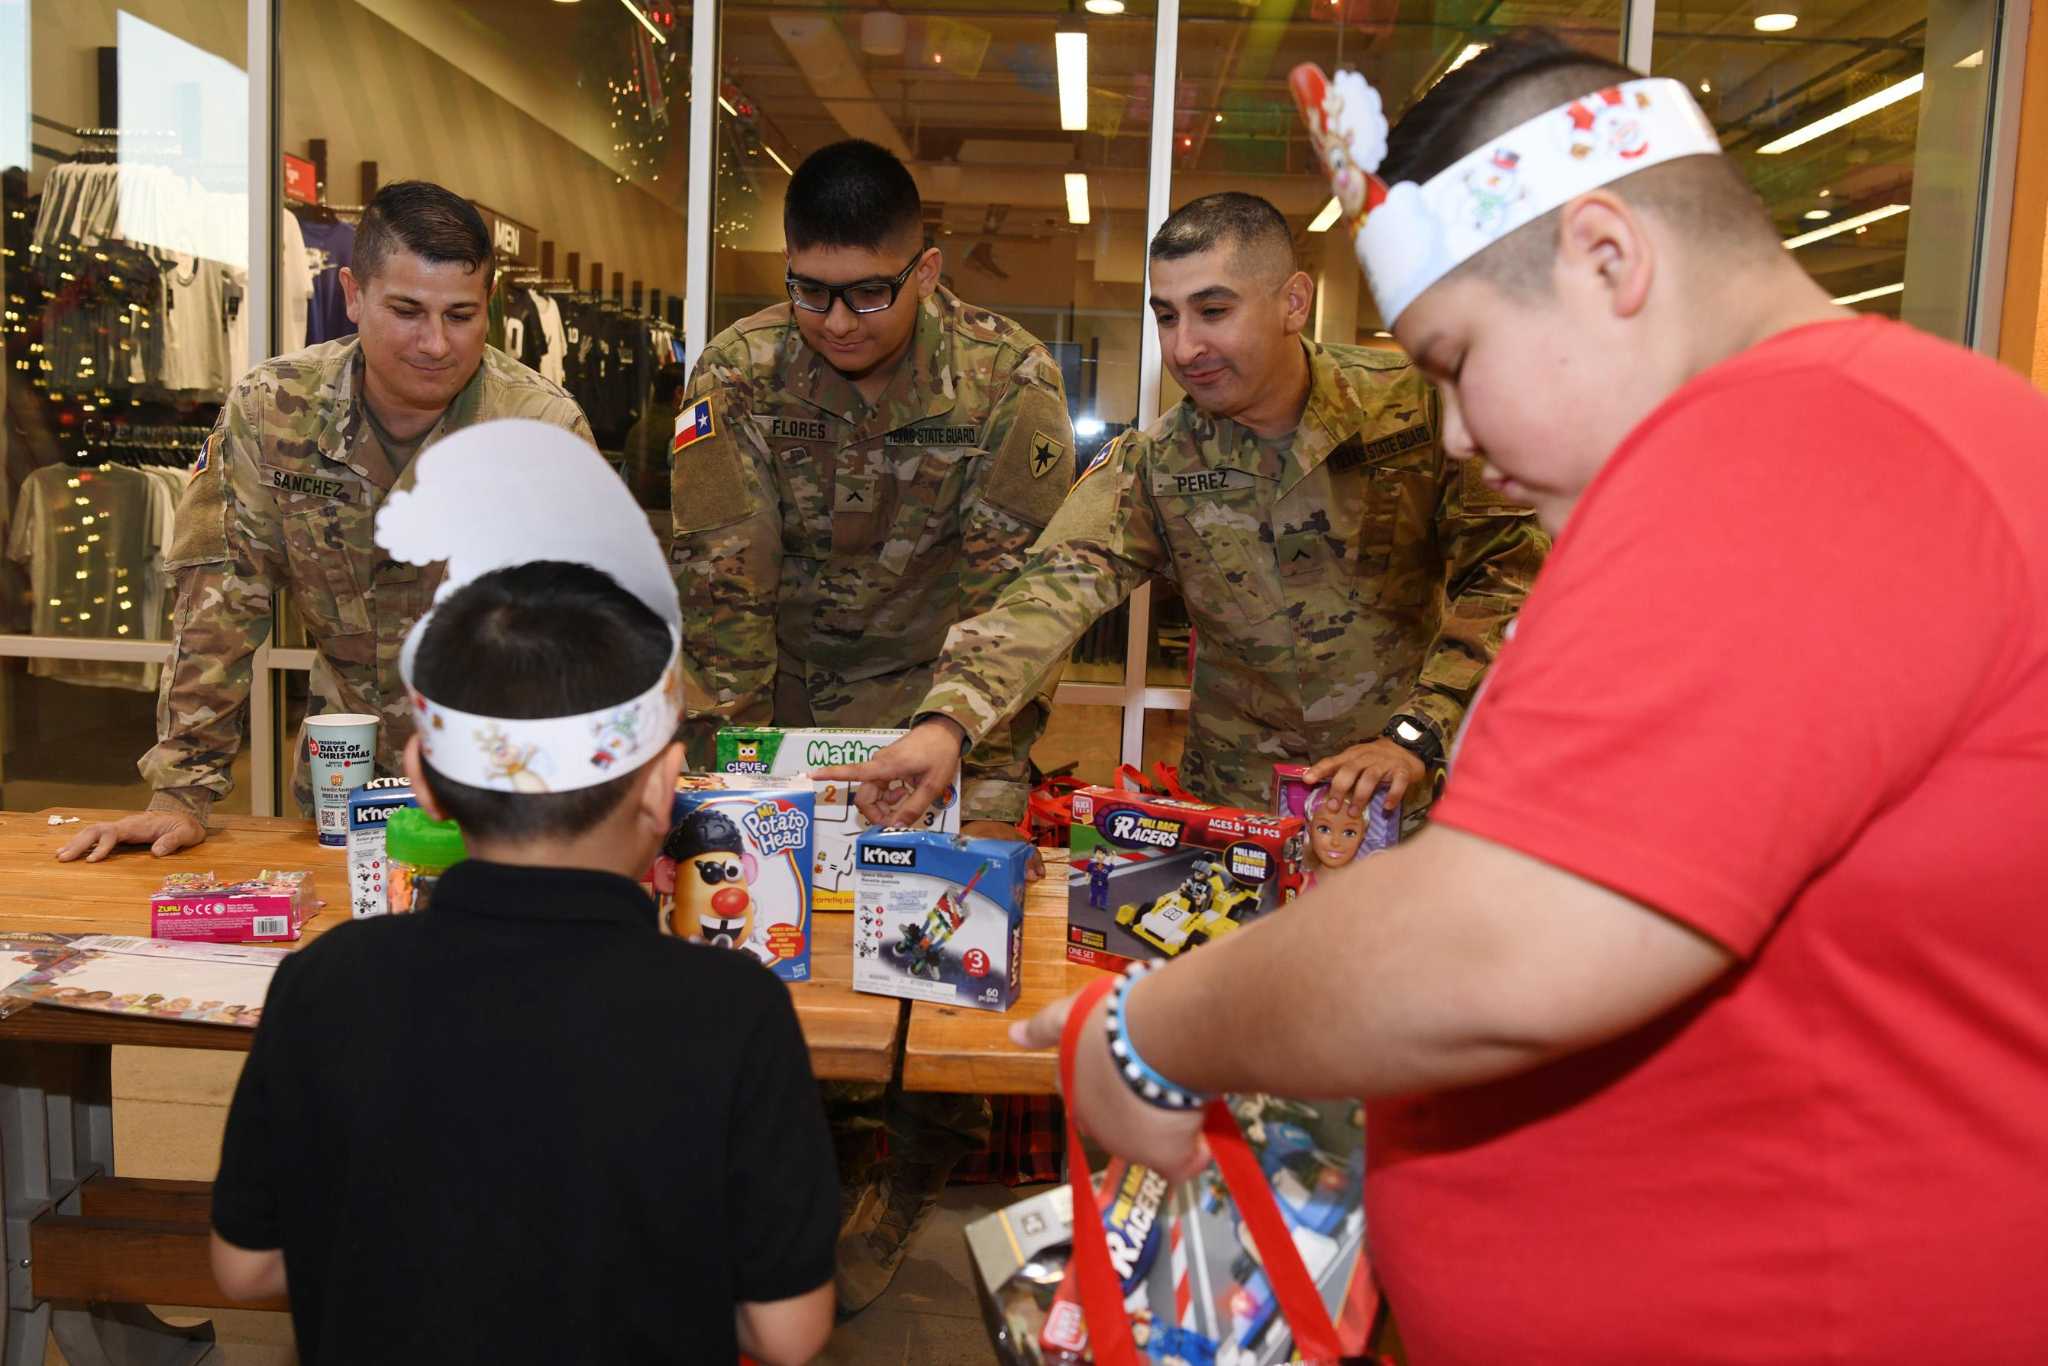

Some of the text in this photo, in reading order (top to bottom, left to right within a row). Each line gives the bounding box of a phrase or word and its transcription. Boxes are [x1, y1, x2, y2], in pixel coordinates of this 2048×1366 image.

[494, 219, 520, 256] MEN
[772, 419, 826, 440] FLORES
[917, 427, 945, 444] STATE
[945, 427, 976, 444] GUARD
[273, 471, 344, 498] SANCHEZ
[1176, 471, 1229, 493] PEREZ
[318, 750, 370, 760] CHRISTMAS
[347, 744, 361, 752] OF
[823, 784, 836, 802] 2
[744, 812, 804, 837] Potato
[923, 812, 934, 826] 3
[1137, 817, 1180, 833] PULL BACK
[1112, 815, 1179, 848] RACERS
[1208, 818, 1233, 831] AGES
[1263, 828, 1281, 839] PCS
[759, 828, 802, 854] Head
[1232, 861, 1266, 879] ENGINE
[970, 950, 983, 968] 3
[985, 987, 998, 997] 60
